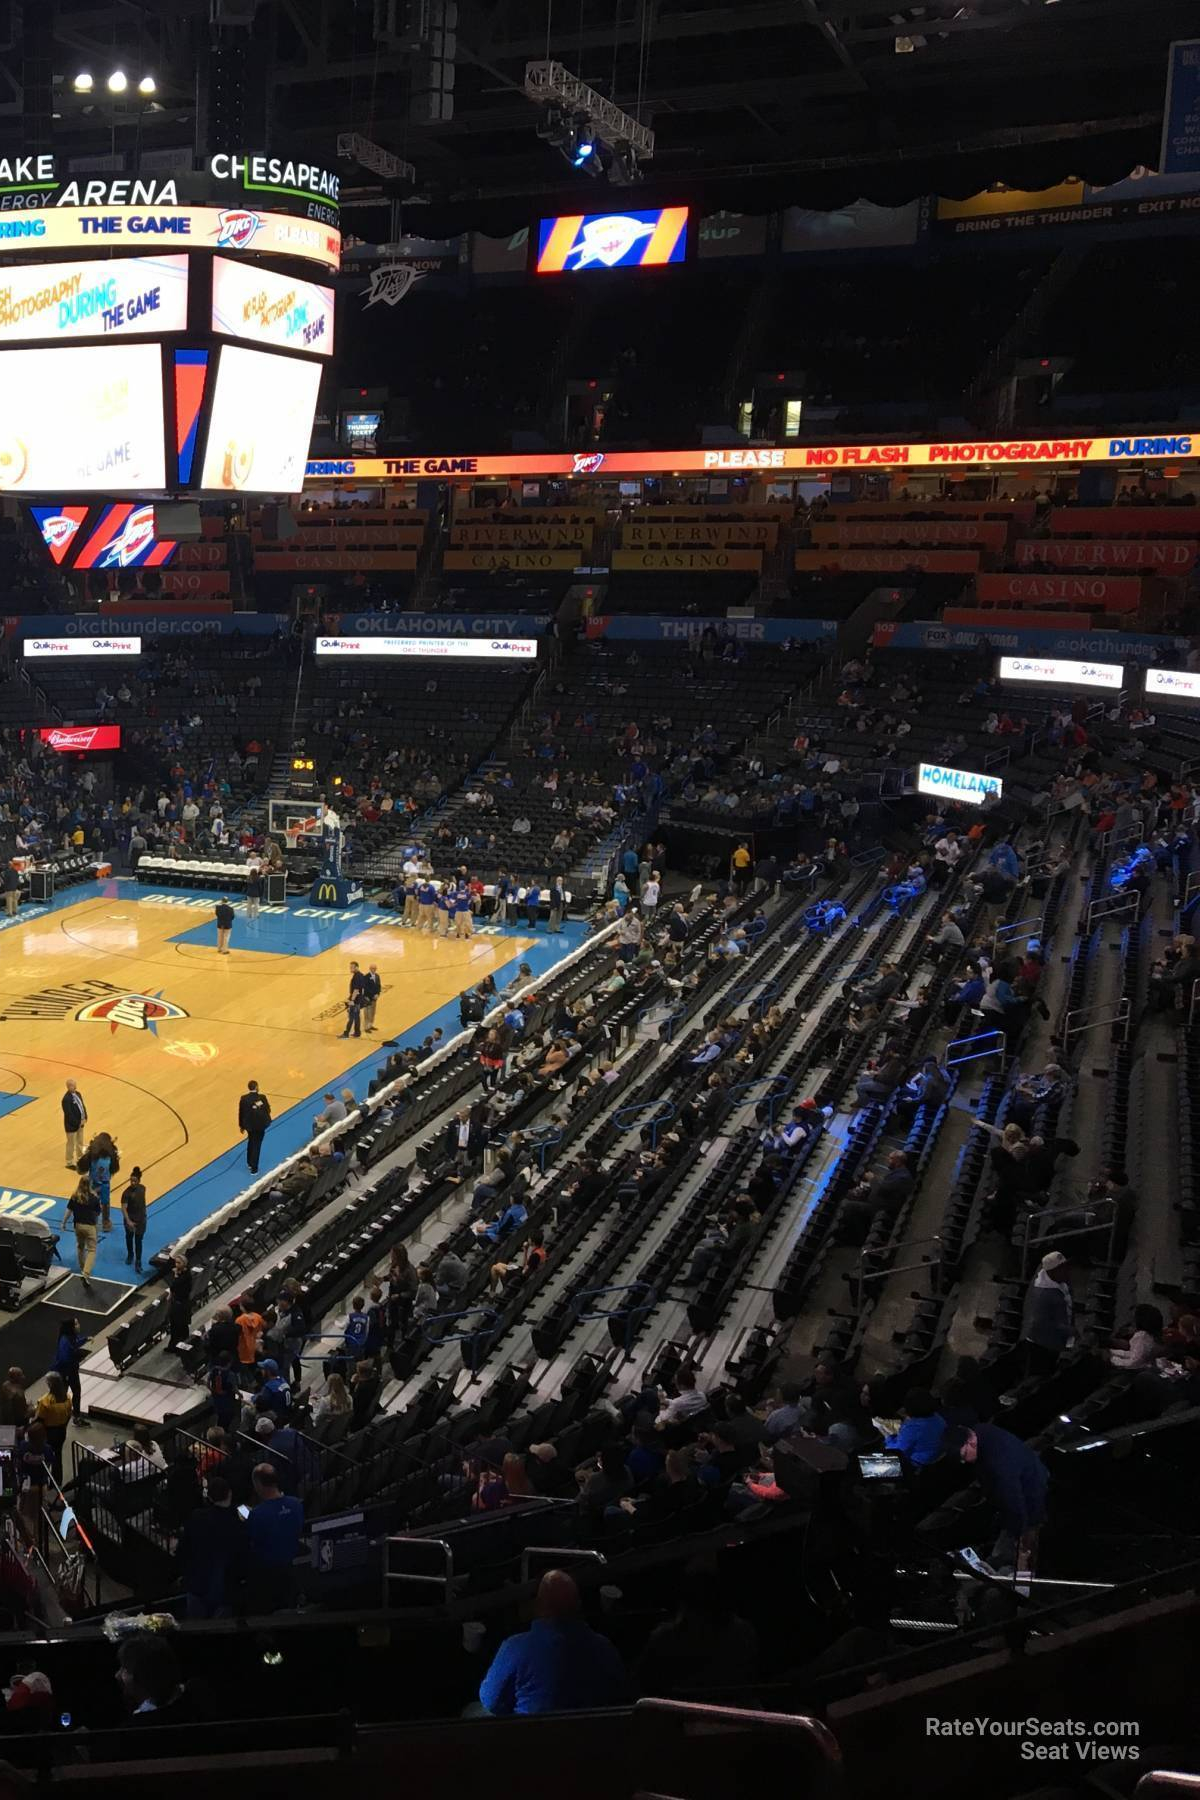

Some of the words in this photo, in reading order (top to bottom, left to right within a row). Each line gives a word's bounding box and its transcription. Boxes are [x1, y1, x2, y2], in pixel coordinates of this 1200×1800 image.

[211, 154, 340, 200] CHESAPEAKE
[56, 180, 179, 206] ARENA
[78, 216, 123, 235] THE
[126, 216, 192, 235] GAME
[955, 217, 1001, 233] BRING
[1005, 214, 1036, 227] THE
[1040, 206, 1113, 224] THUNDER
[1137, 199, 1176, 214] EXIT
[56, 278, 118, 330] DURING
[101, 302, 126, 332] THE
[127, 286, 161, 321] GAME
[704, 450, 786, 468] PLEASE
[805, 448, 837, 466] NO
[842, 446, 910, 464] FLASH
[929, 440, 1093, 462] PHOTOGRAPHY
[1109, 436, 1192, 457] DURING
[384, 459, 421, 475] THE
[424, 458, 478, 474] GAME
[459, 527, 586, 542] RIVERWIND
[631, 527, 769, 541] RIVERWIND
[295, 557, 374, 569] CASINO
[471, 554, 553, 568] CASINO
[642, 553, 730, 568] CASINO
[1021, 544, 1191, 565] RIVERWIND
[1008, 579, 1108, 599] CASINO
[64, 615, 223, 635] okcthunder.com
[354, 617, 466, 634] OKLAHOMA
[471, 618, 519, 634] CITY
[821, 620, 838, 630] 101
[875, 623, 895, 633] 102
[927, 629, 950, 642] FOX
[921, 766, 999, 794] HOMELAND
[291, 907, 362, 921] CITY
[0, 979, 132, 1022] THUNDER
[106, 999, 147, 1030] OKC
